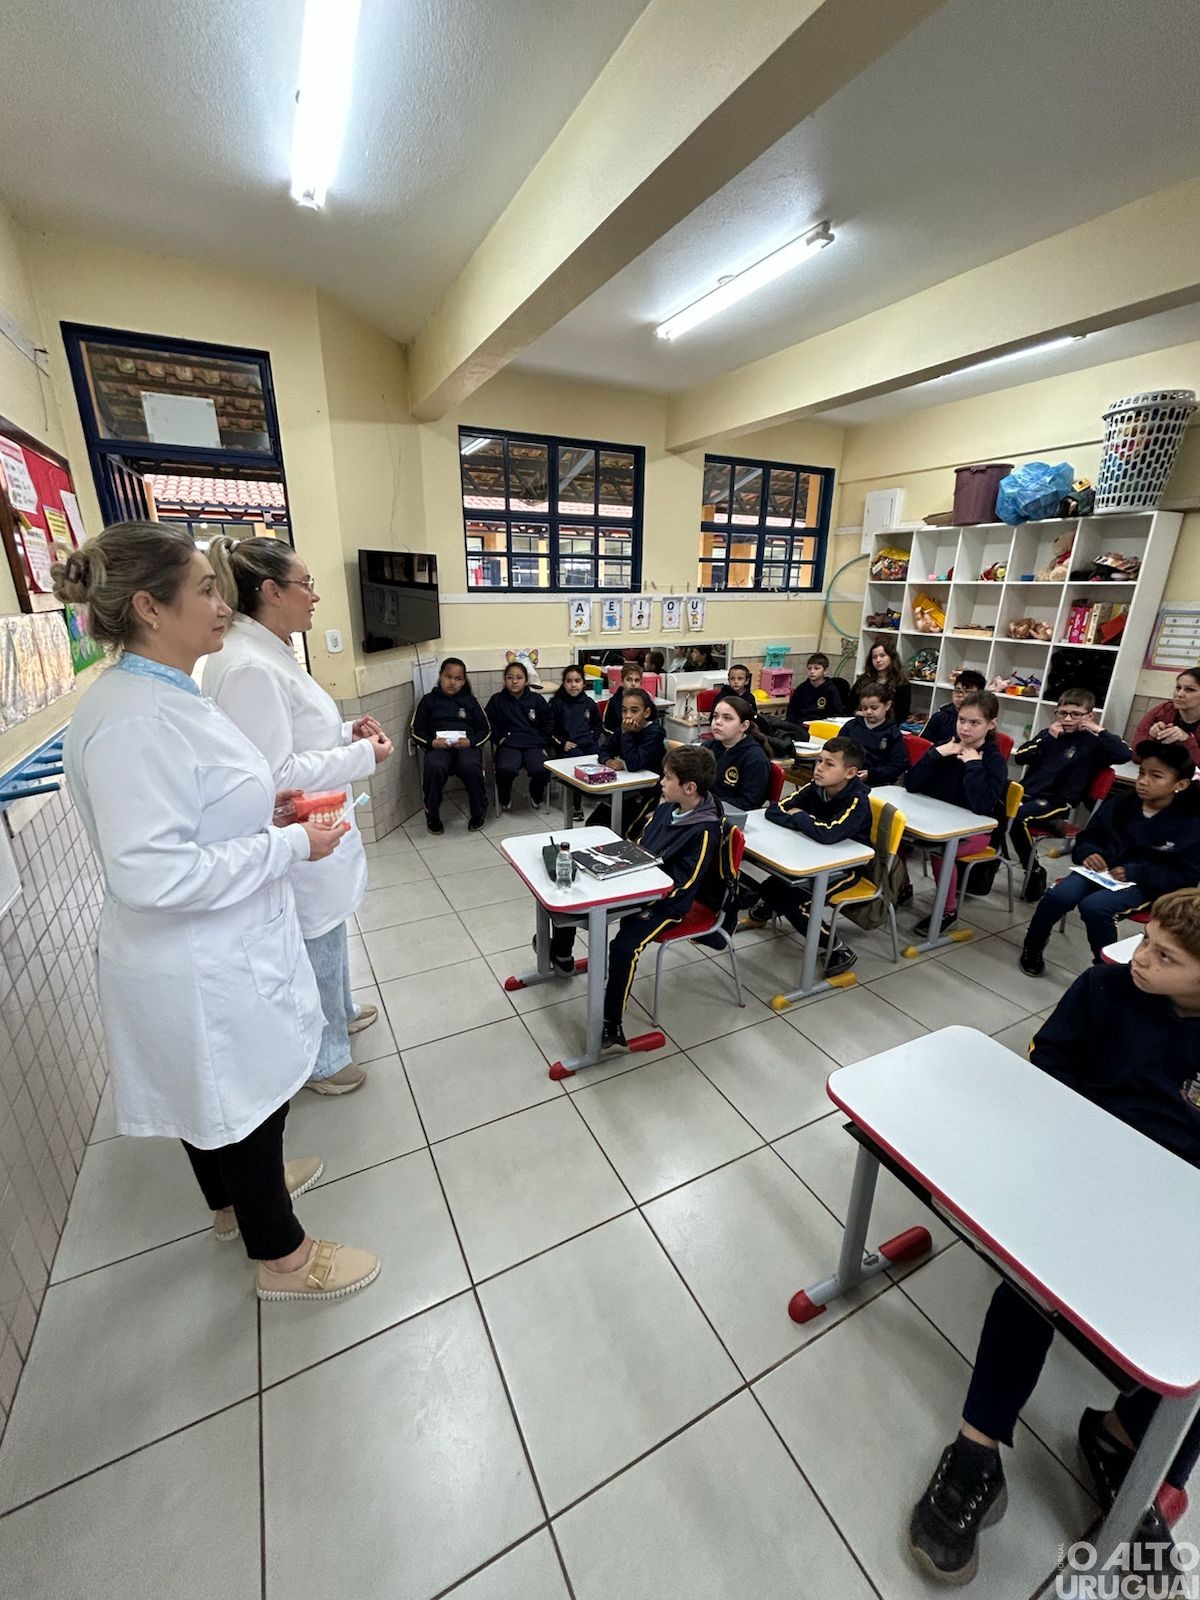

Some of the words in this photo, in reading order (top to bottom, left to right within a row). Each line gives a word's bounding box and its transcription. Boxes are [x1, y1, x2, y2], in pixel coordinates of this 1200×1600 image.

[576, 602, 584, 612] A
[609, 601, 615, 611] E
[639, 600, 643, 610] I
[667, 601, 675, 611] O
[691, 600, 699, 610] U
